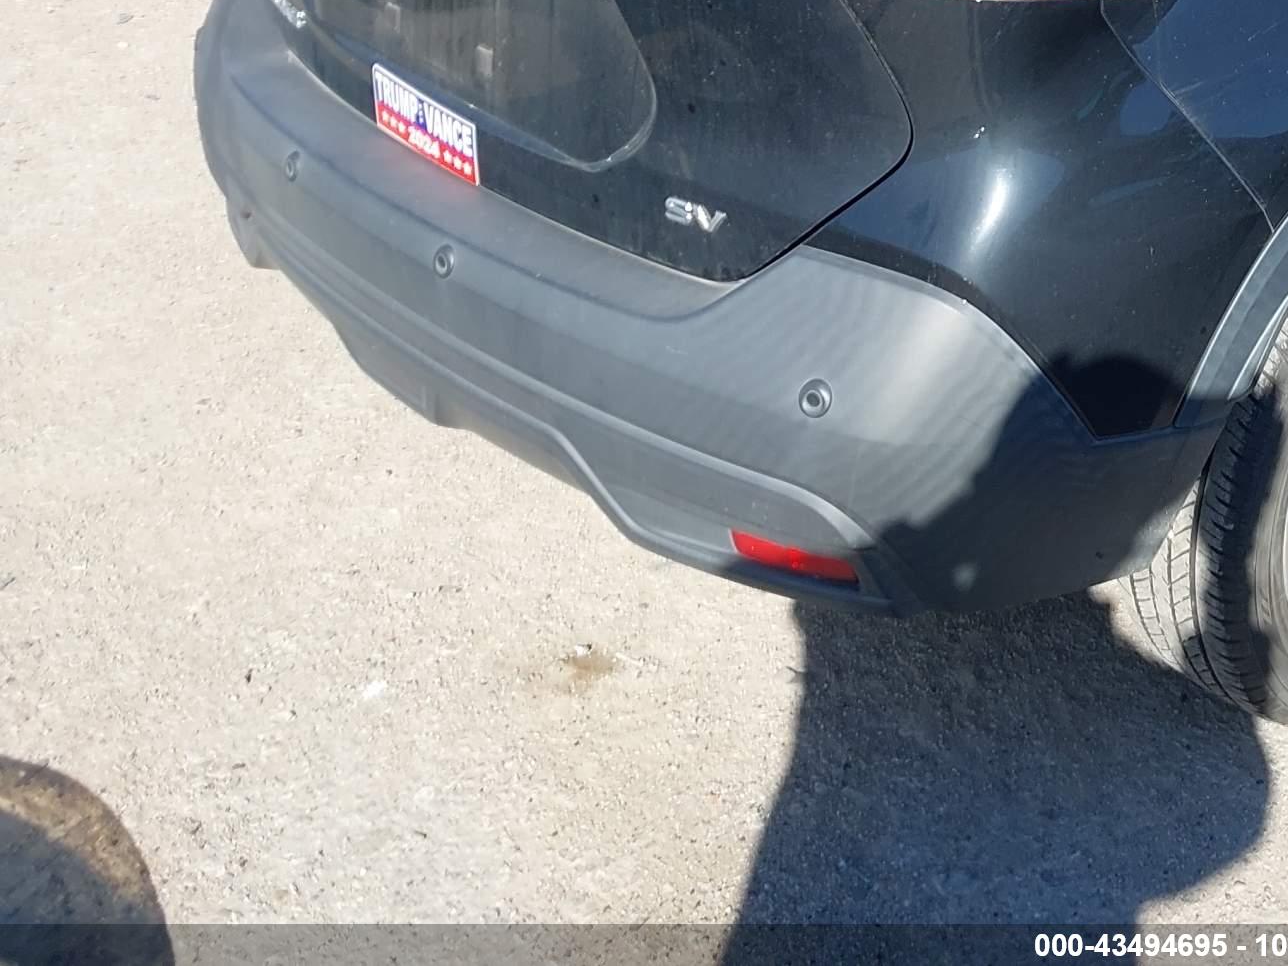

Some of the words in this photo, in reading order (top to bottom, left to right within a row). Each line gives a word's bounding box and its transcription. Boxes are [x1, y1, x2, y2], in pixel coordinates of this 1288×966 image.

[375, 71, 418, 125] TRUMP
[423, 101, 473, 158] VANCE
[407, 125, 441, 159] 2024
[664, 195, 727, 233] SV
